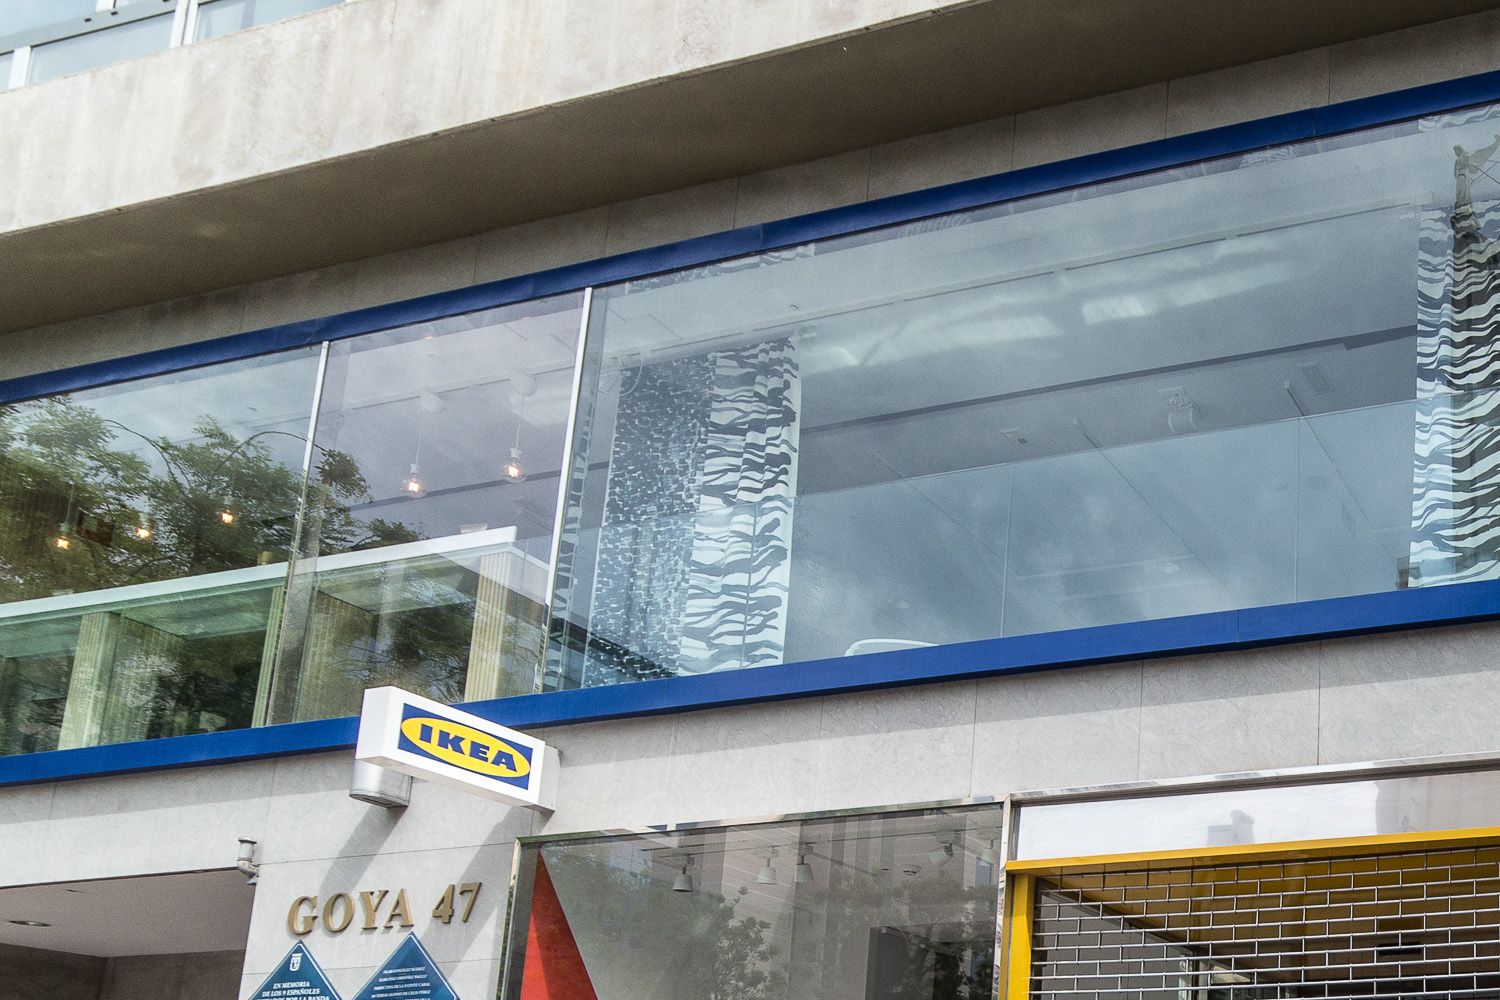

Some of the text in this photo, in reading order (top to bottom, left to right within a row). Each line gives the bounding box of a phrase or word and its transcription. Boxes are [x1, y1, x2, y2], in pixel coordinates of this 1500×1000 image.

[419, 723, 517, 773] IKEA
[287, 882, 482, 935] GOYA 47
